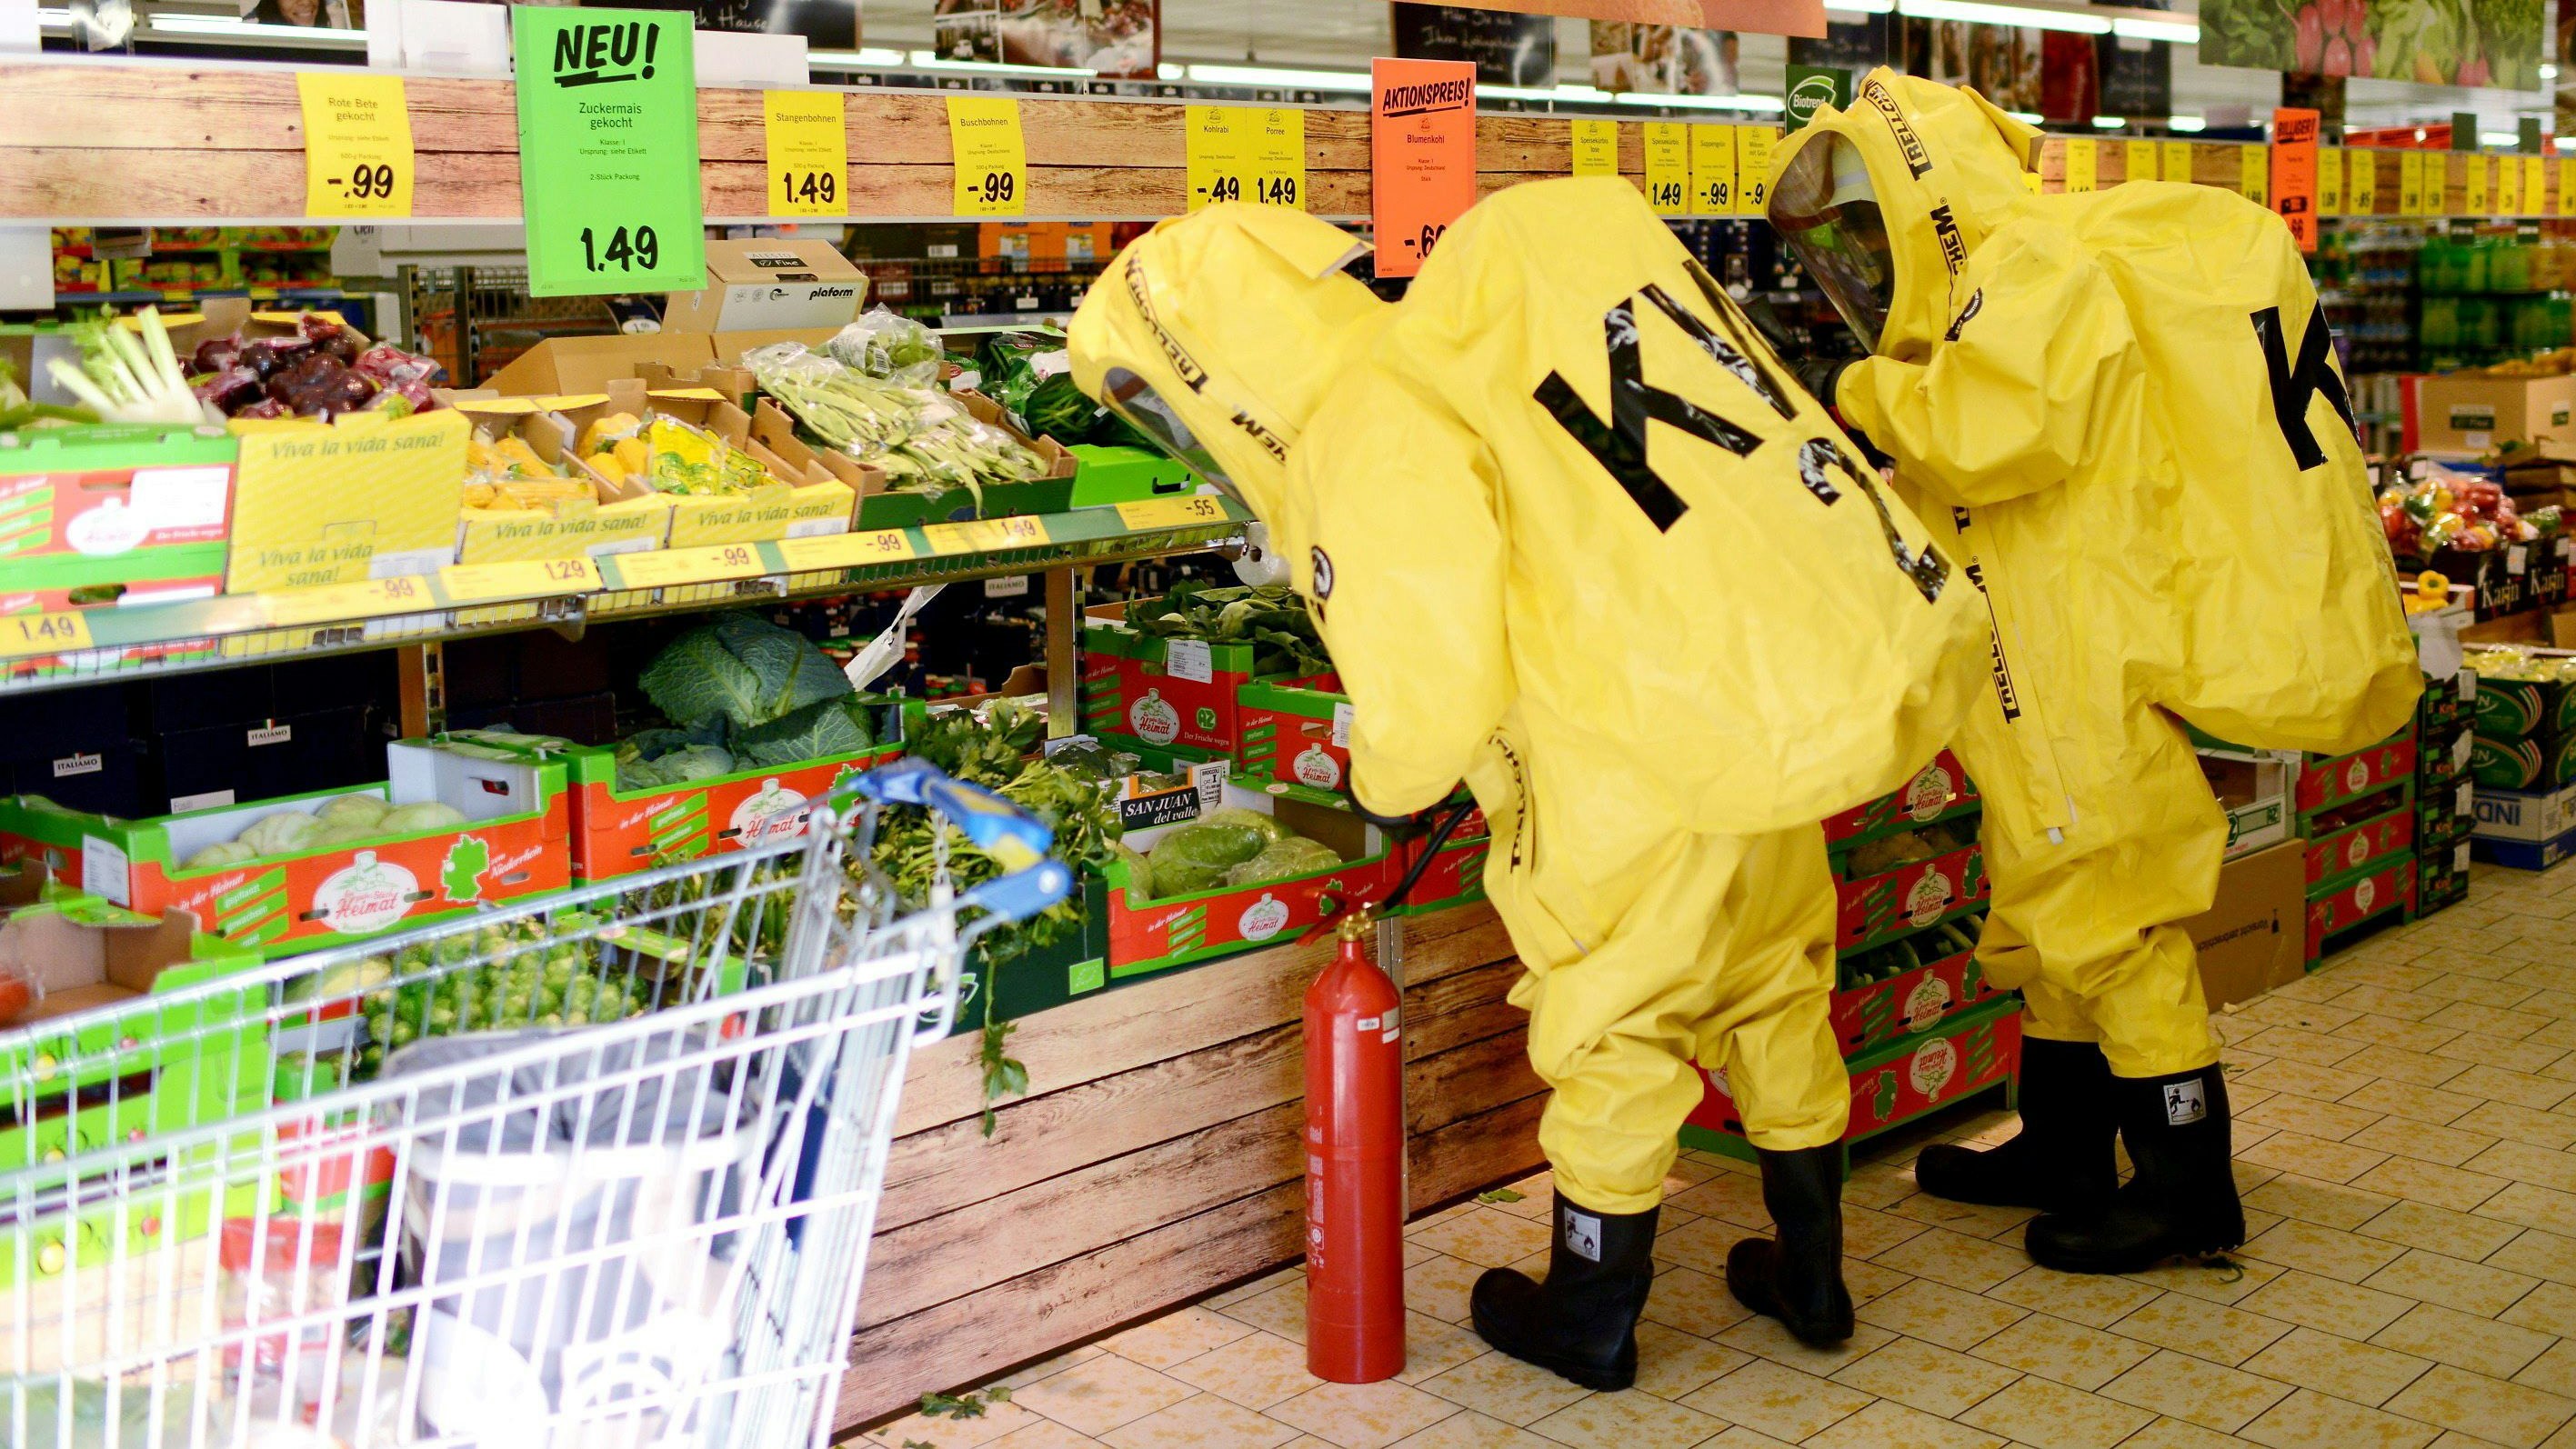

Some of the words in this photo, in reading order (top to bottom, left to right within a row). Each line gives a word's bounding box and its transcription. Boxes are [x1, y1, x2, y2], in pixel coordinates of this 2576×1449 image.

[554, 22, 660, 80] NEU!
[328, 97, 352, 108] Rote
[356, 99, 378, 109] Bete
[1382, 77, 1471, 111] AKTIONSPREIS!
[1793, 95, 1827, 107] Biotrend
[336, 113, 376, 122] gekocht
[579, 103, 642, 115] Zuckermais
[776, 113, 837, 124] Stangenbohnen
[590, 117, 634, 130] gekocht
[960, 118, 1008, 127] Buschbohnen
[1203, 125, 1229, 134] Kohlrabi
[1266, 126, 1286, 135] Porree
[1864, 79, 1933, 182] TRELLCHE
[1407, 135, 1445, 145] Blumenkohl
[327, 164, 394, 199] -.99
[615, 173, 641, 181] Packung
[784, 172, 835, 205] 1.49
[967, 172, 1014, 203] -.99
[1197, 175, 1240, 204] -.49
[1258, 176, 1296, 205] 1.49
[1652, 182, 1681, 206] 1.49
[1700, 182, 1728, 205] -.99
[1745, 182, 1767, 205] -.9
[580, 225, 658, 273] 1.49
[808, 286, 855, 301] plaform
[2249, 297, 2362, 472] K
[272, 441, 316, 459] Viva
[321, 438, 339, 455] la
[346, 435, 386, 454] vida
[393, 431, 446, 452] sana!
[699, 511, 733, 527] Viva
[737, 509, 752, 523] la
[756, 505, 790, 522] vida
[794, 502, 835, 517] sana!
[1186, 498, 1216, 517] -.55
[496, 521, 534, 539] Viva
[537, 520, 554, 536] la
[560, 517, 596, 534] vida
[600, 514, 648, 532] sana!
[866, 533, 902, 552] -.99
[258, 548, 302, 568] Viva
[308, 547, 326, 564] la
[331, 544, 375, 562] vida
[711, 547, 750, 567] -.99
[285, 565, 341, 586] sana!
[545, 559, 586, 581] 1.29
[987, 580, 1026, 591] ITALIAMO
[250, 729, 287, 740] ITALIAMO
[1139, 715, 1170, 735] Heimat
[1194, 733, 1214, 744] Frische
[1214, 738, 1229, 746] wegen
[57, 758, 98, 771] ITALIAMO
[1202, 768, 1220, 776] BROCCOLI
[1302, 766, 1331, 784] Heimat
[645, 796, 675, 816] Heimat
[1126, 799, 1156, 817] SAN
[1156, 793, 1192, 811] JUAN
[1914, 794, 1942, 811] Heimat
[1154, 809, 1170, 824] del
[1172, 805, 1198, 821] valle
[209, 872, 246, 896] Heimat
[335, 892, 399, 920] Heimat
[1914, 899, 1942, 917] Heimat
[1248, 918, 1279, 934] Heimat
[1912, 1002, 1942, 1023] Heimat
